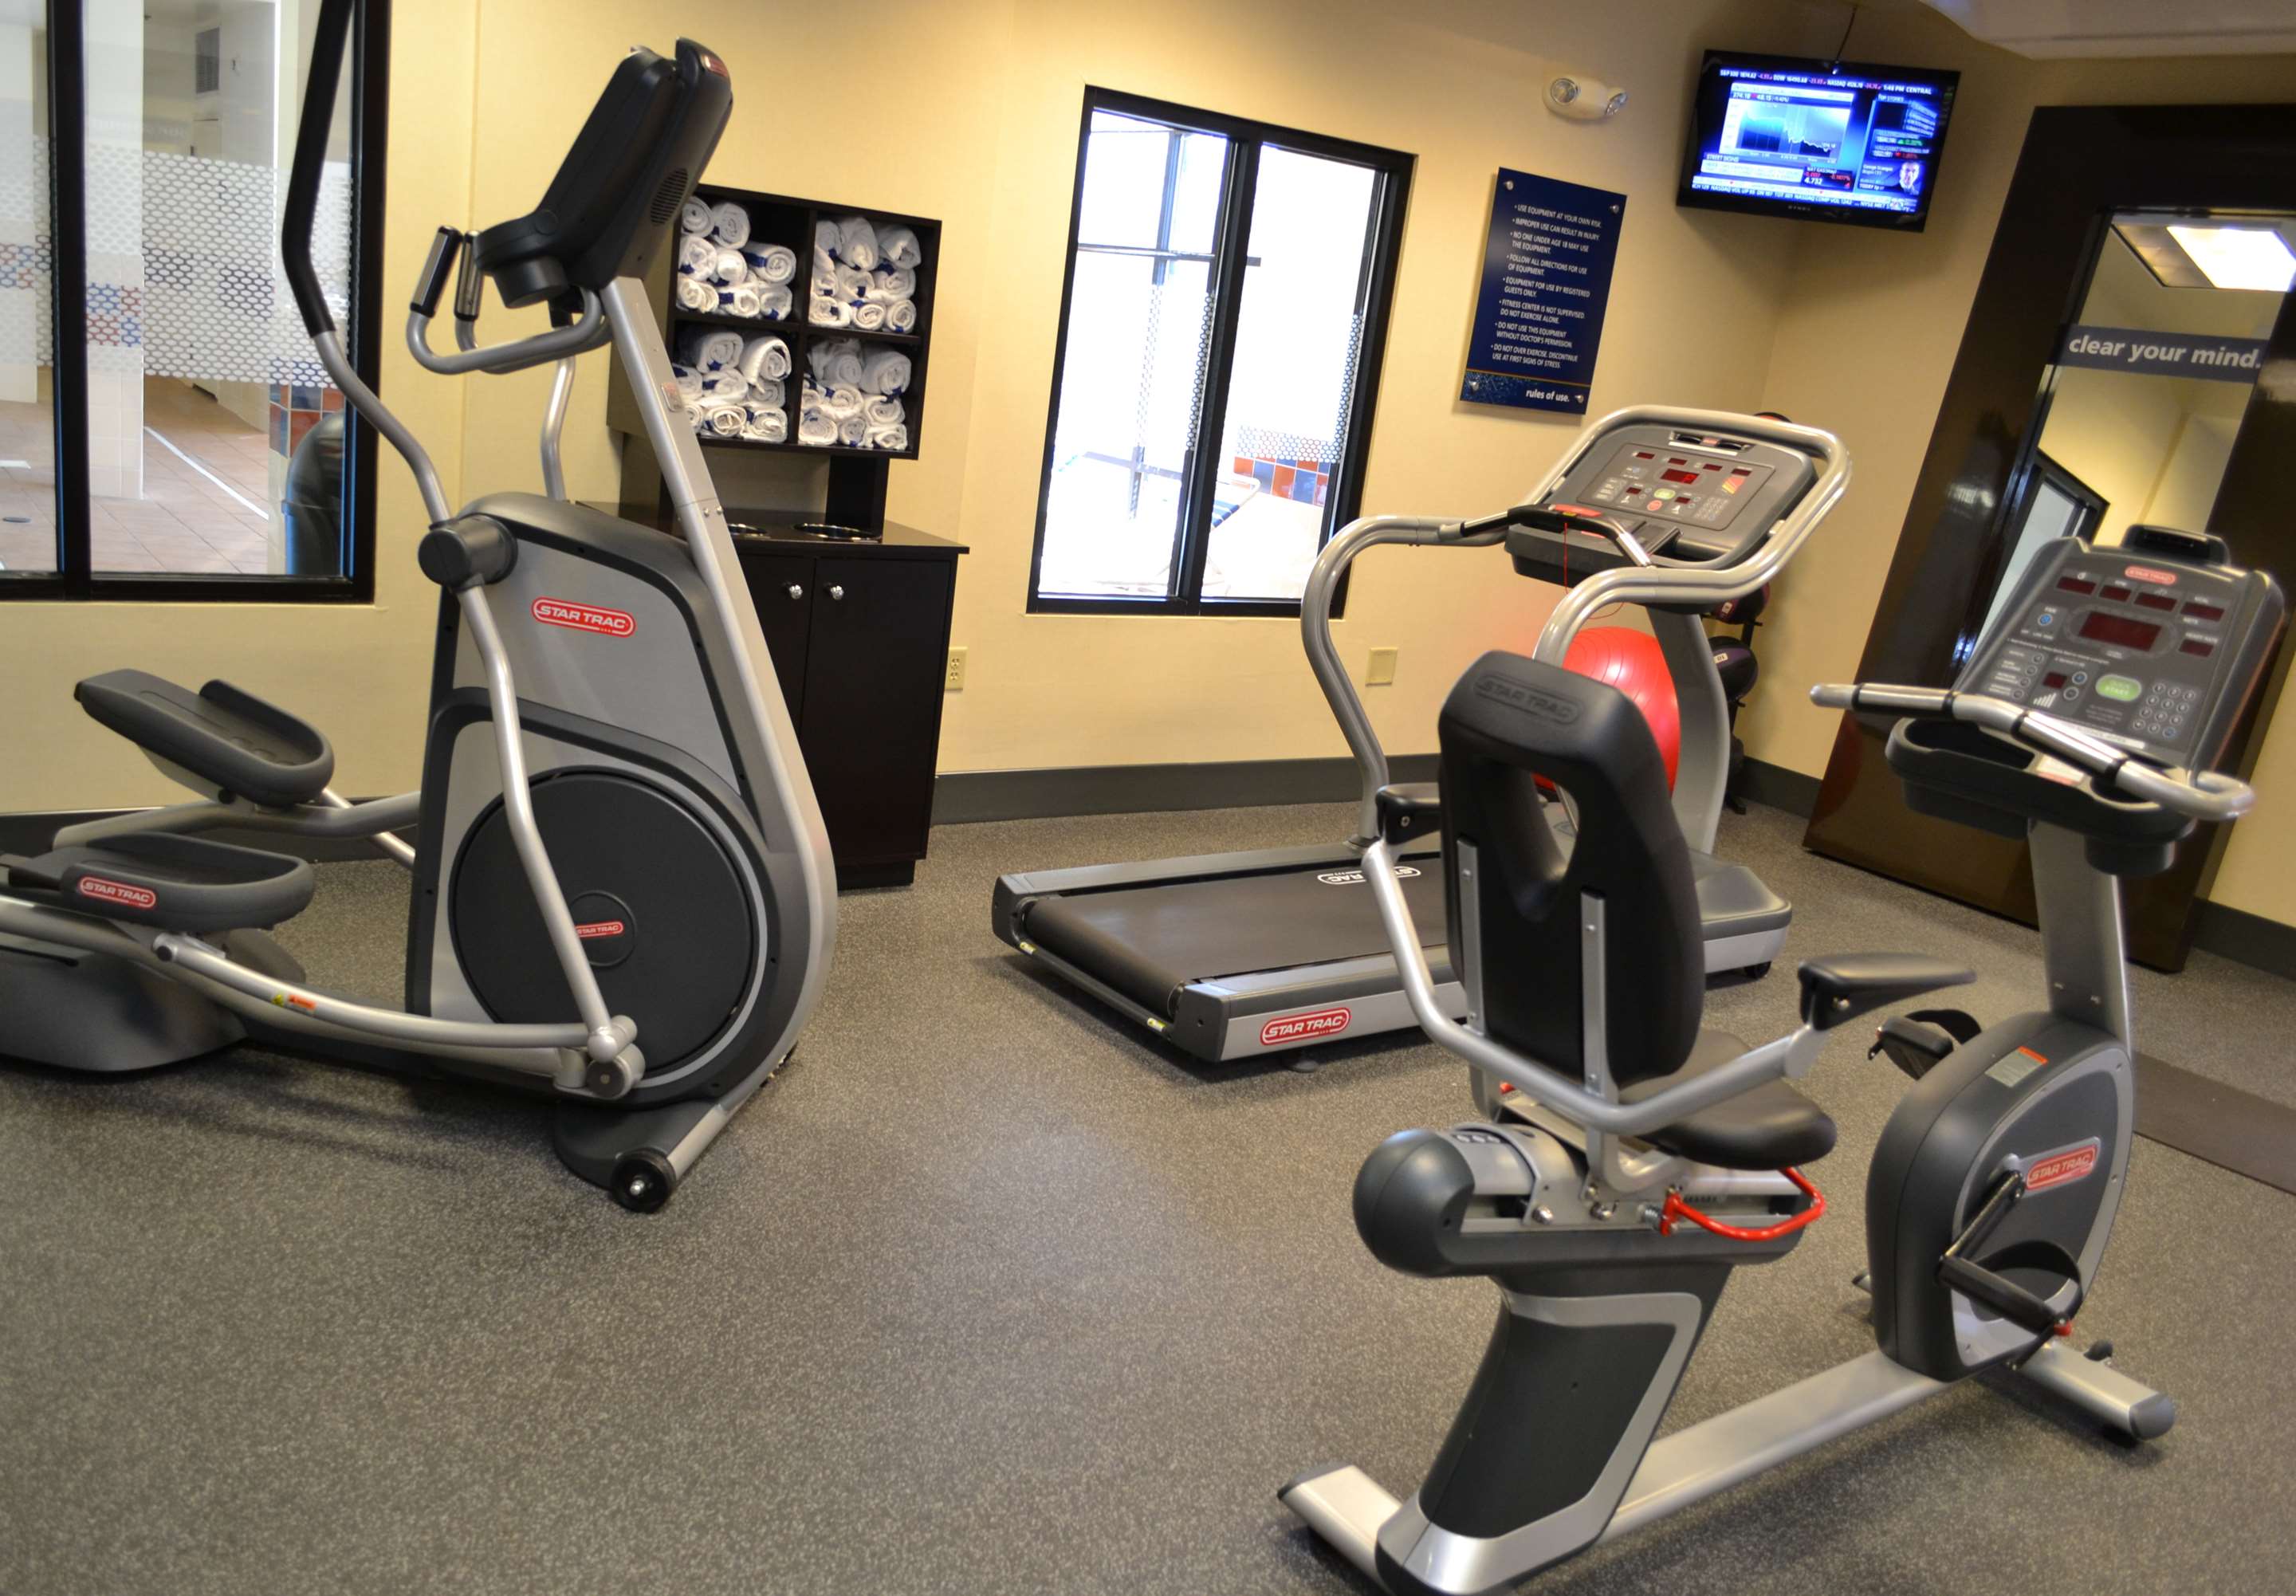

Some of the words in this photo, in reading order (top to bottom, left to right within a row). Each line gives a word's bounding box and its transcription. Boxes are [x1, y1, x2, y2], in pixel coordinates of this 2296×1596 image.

[1905, 86, 1932, 95] CENTRAL
[1518, 204, 1527, 213] USE
[1527, 206, 1556, 218] EQUIPMENT
[1563, 214, 1578, 223] YOUR
[1578, 217, 1590, 226] OWN
[1516, 218, 1539, 229] IMPROPER
[1561, 226, 1578, 237] RESULT
[1512, 240, 1522, 249] THE
[1522, 233, 1532, 242] ONE
[1533, 235, 1551, 245] UNDER
[1509, 254, 1531, 264] FOLLOW
[1540, 259, 1568, 271] DIRECTIONS
[1568, 265, 1578, 273] FOR
[1504, 286, 1523, 296] GUESTS
[1505, 277, 1535, 288] EQUIPMENT
[1563, 287, 1591, 298] REGISTERED
[1501, 299, 1521, 309] FITNESS
[1521, 302, 1539, 312] CENTER
[1509, 309, 1520, 318] NOT
[1520, 311, 1543, 321] EXERCISE
[1496, 330, 1520, 340] WITHOUT
[1539, 328, 1567, 339] EQUIPMENT
[1548, 352, 1578, 363] DISCONTINUE
[2068, 334, 2125, 356] clear
[2127, 344, 2187, 364] your
[2191, 347, 2263, 369] mind.
[1525, 389, 1545, 399] rules
[1545, 391, 1555, 400] of
[540, 604, 581, 620] STAR
[582, 612, 626, 629] TRAC
[84, 881, 116, 895] STAR
[117, 888, 150, 902] TRAC
[1268, 1022, 1305, 1037] STAR
[1306, 1016, 1344, 1032] TRAC
[2031, 1163, 2061, 1178] STAR
[2062, 1154, 2090, 1170] TRAC
